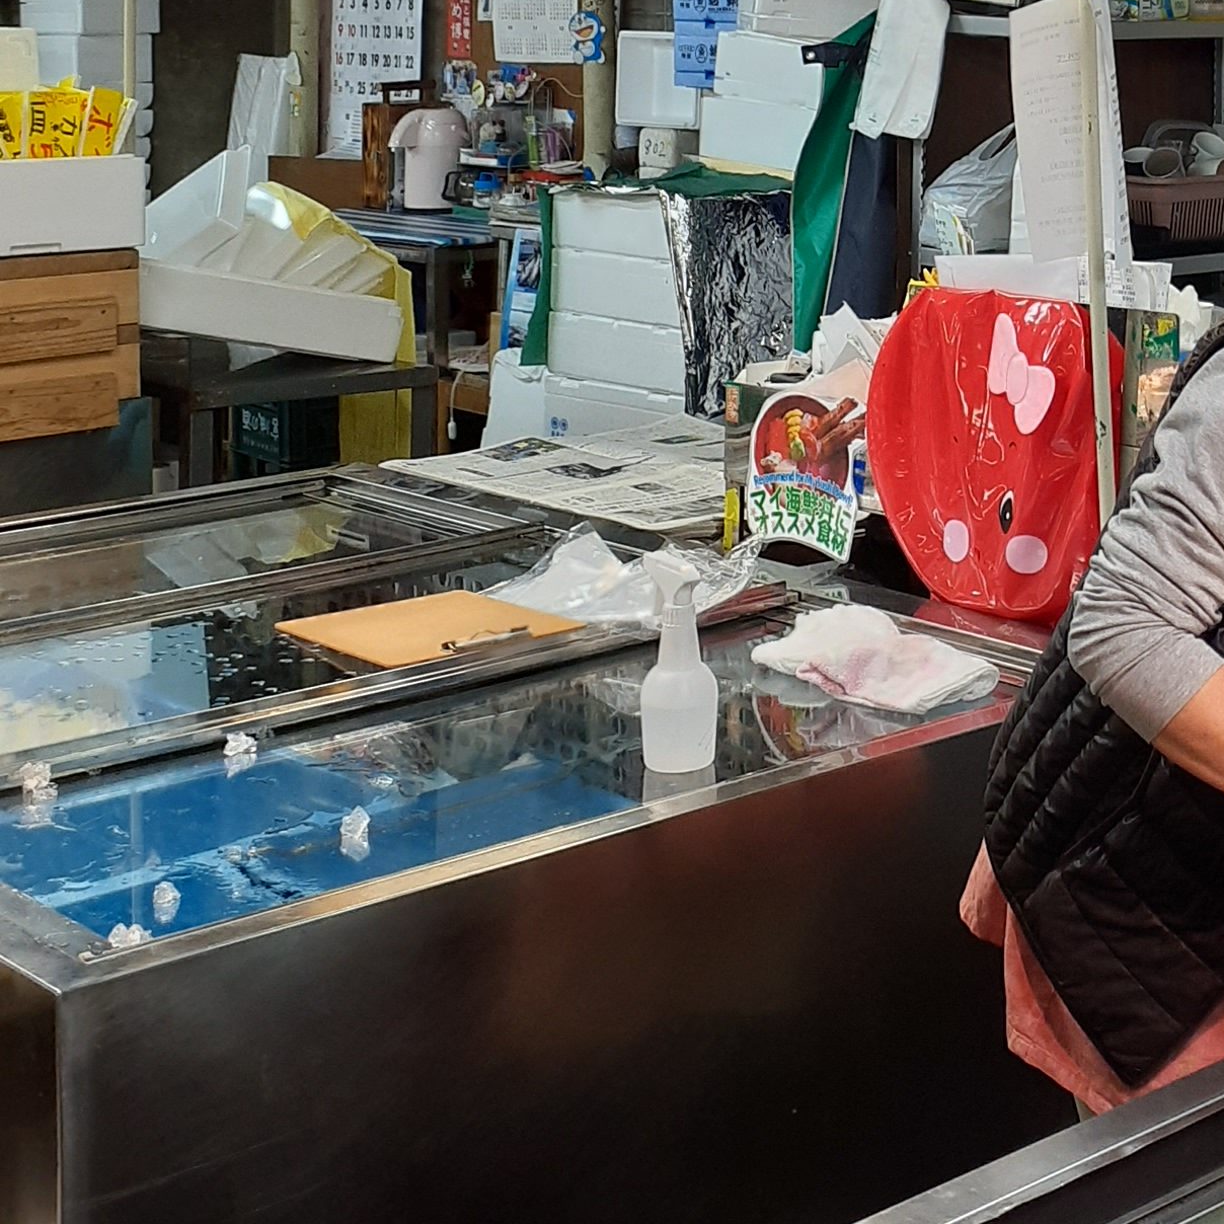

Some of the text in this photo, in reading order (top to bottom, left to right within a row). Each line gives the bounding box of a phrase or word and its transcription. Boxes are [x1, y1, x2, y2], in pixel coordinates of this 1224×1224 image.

[338, 23, 415, 40] 9 10 11 12 13 14 15
[336, 52, 414, 69] 16 17 18 19 20 21 22
[357, 81, 366, 95] 25
[750, 486, 852, 533] マイ海鮮丼に
[754, 511, 848, 556] オススメ食材
